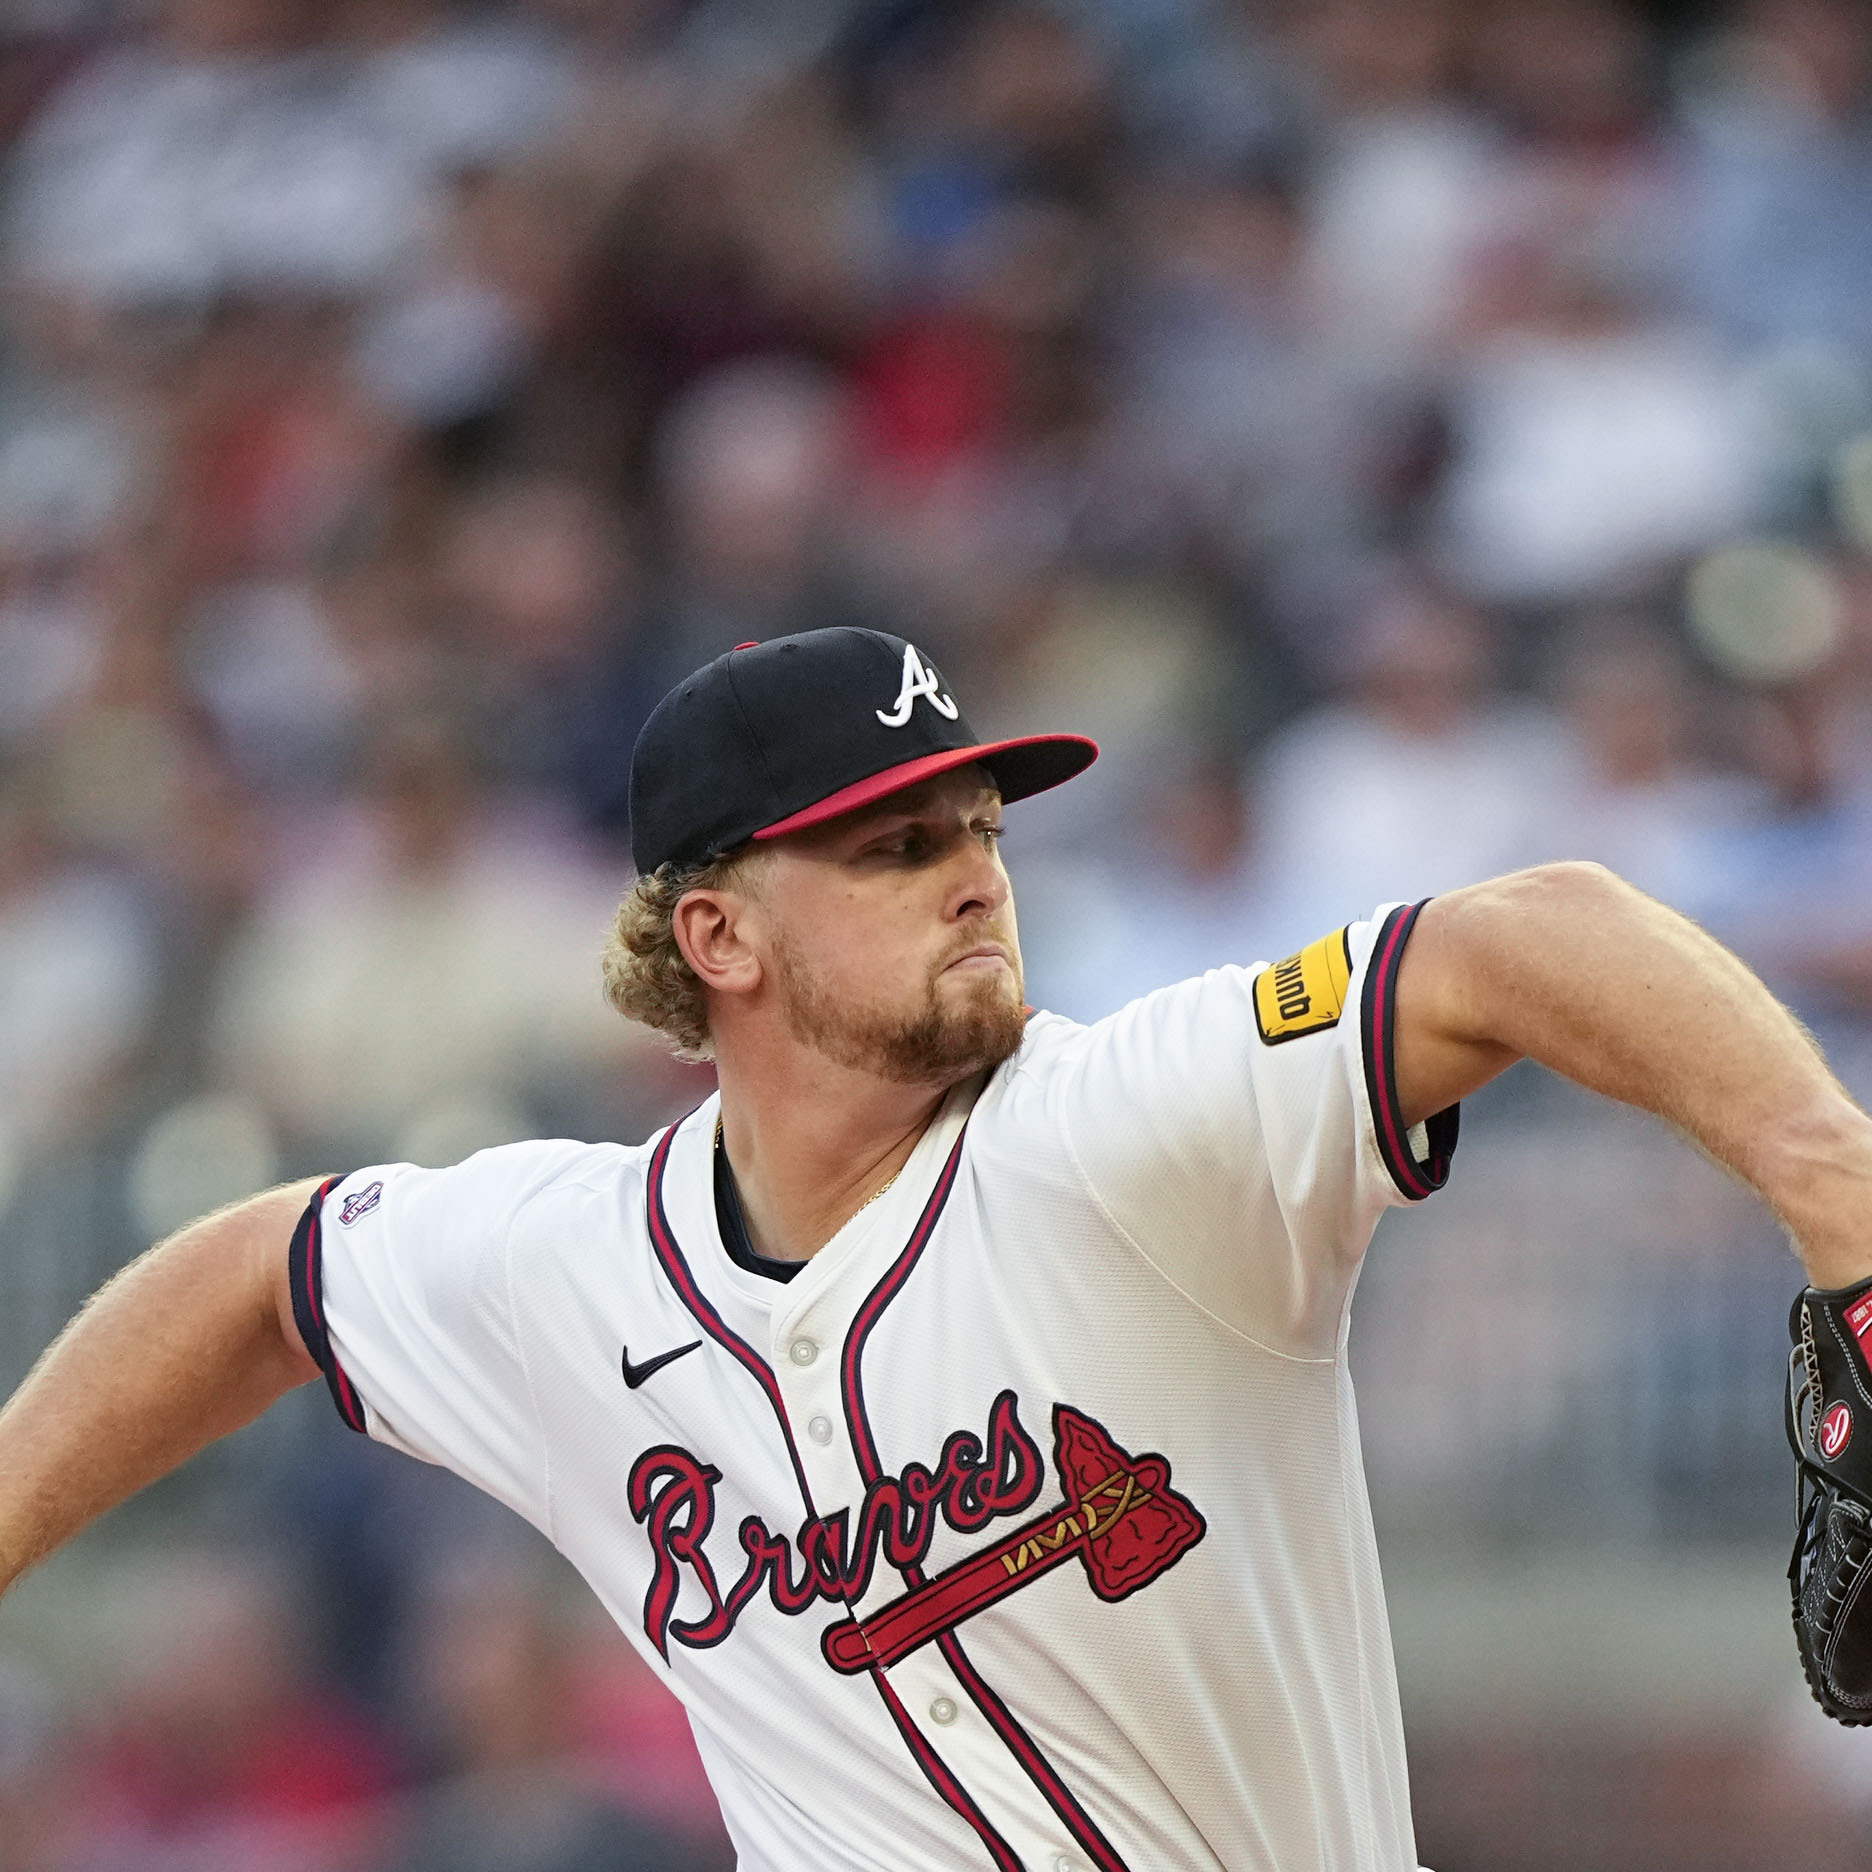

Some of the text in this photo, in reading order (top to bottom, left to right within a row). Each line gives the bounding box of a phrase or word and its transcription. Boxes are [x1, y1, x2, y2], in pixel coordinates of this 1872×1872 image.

[875, 644, 958, 728] A
[1823, 1408, 1849, 1454] R
[628, 1389, 1045, 1669] Braves
